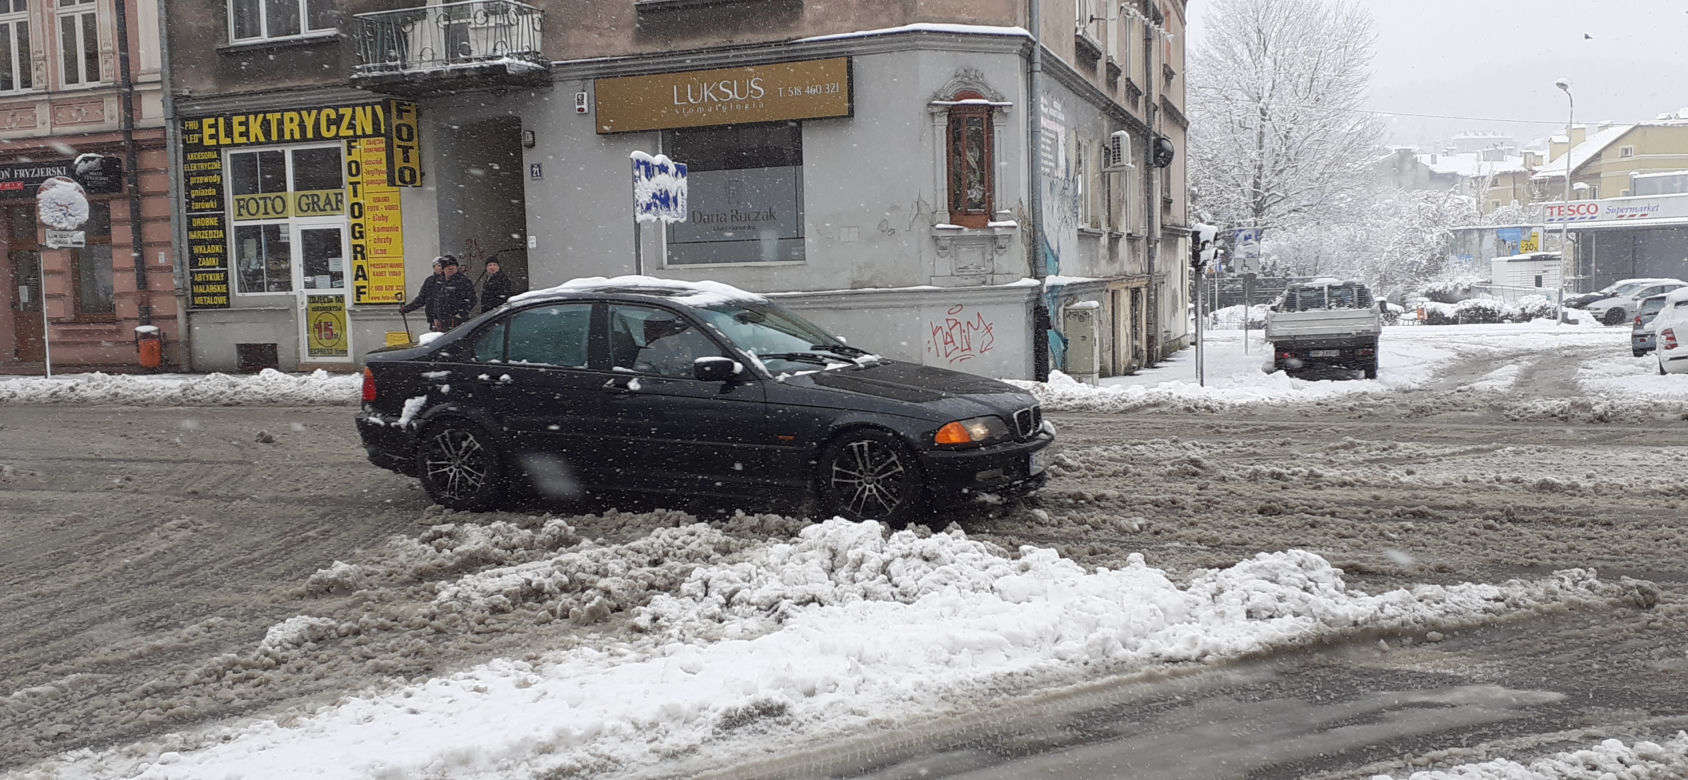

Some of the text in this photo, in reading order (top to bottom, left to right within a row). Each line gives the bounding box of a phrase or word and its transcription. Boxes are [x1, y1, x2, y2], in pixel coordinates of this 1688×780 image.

[673, 77, 765, 105] LUKSUS
[788, 86, 802, 97] 518
[805, 84, 822, 95] 460
[825, 82, 839, 93] 321
[202, 105, 385, 146] ELEKTRYCZNY
[395, 101, 417, 186] FOTO
[187, 151, 218, 160] AKCESORIA
[184, 162, 221, 171] ELEKTRYCZNE
[532, 167, 541, 177] 21
[14, 166, 67, 179] FRYZJERSKI
[190, 174, 221, 185] przewody
[190, 187, 217, 198] gniazda
[191, 200, 218, 210] żarówki
[235, 191, 344, 217] FOTO GRAF
[692, 207, 777, 223] Daria Ruczak
[1547, 203, 1660, 217] TESCO Supermarket
[192, 217, 219, 227] DROBNE
[346, 139, 369, 302] FOTOGRAF
[373, 225, 400, 233] komunie
[198, 257, 220, 267] ZAMKI
[193, 284, 228, 293] MALARSKIE
[194, 296, 228, 305] METALOWE
[314, 320, 333, 340] 15
